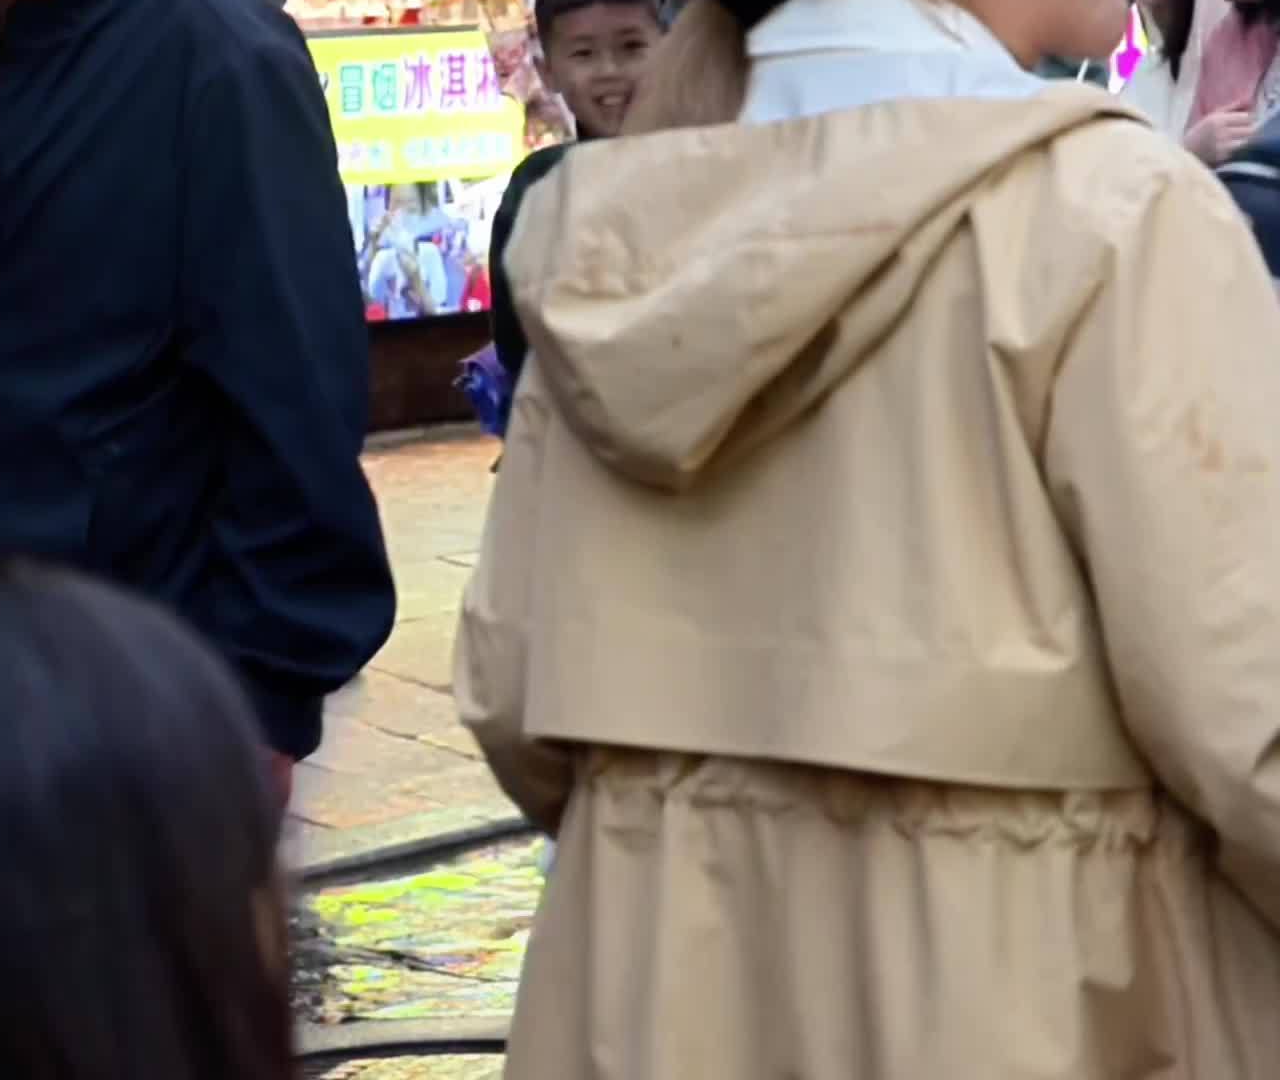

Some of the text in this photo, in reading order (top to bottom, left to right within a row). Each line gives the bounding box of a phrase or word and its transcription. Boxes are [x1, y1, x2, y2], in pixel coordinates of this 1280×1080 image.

[322, 52, 500, 113] 冒烟冰淇淋
